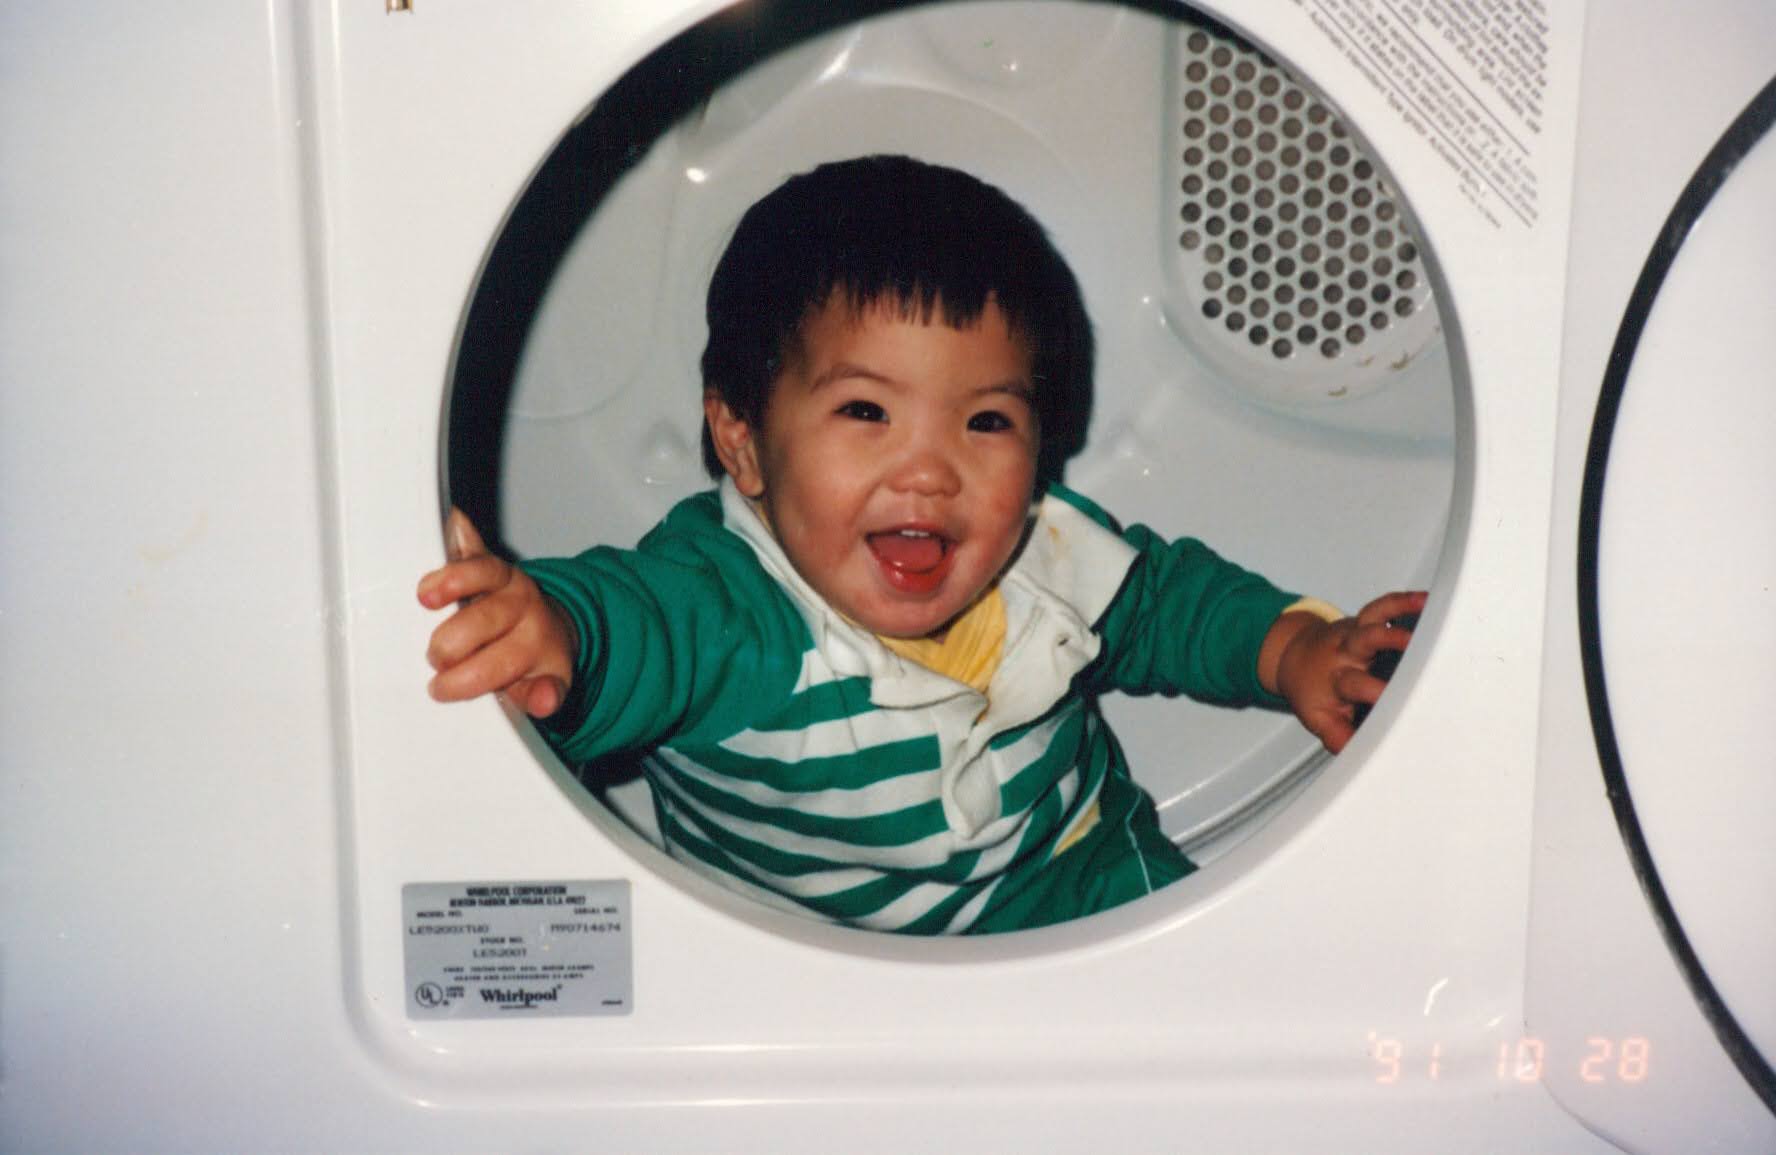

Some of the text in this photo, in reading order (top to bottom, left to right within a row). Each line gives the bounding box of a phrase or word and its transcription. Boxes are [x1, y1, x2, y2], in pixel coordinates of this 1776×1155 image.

[466, 886, 567, 896] WHIRLPOOL CORPORATION
[480, 987, 558, 1008] Whirlpool
